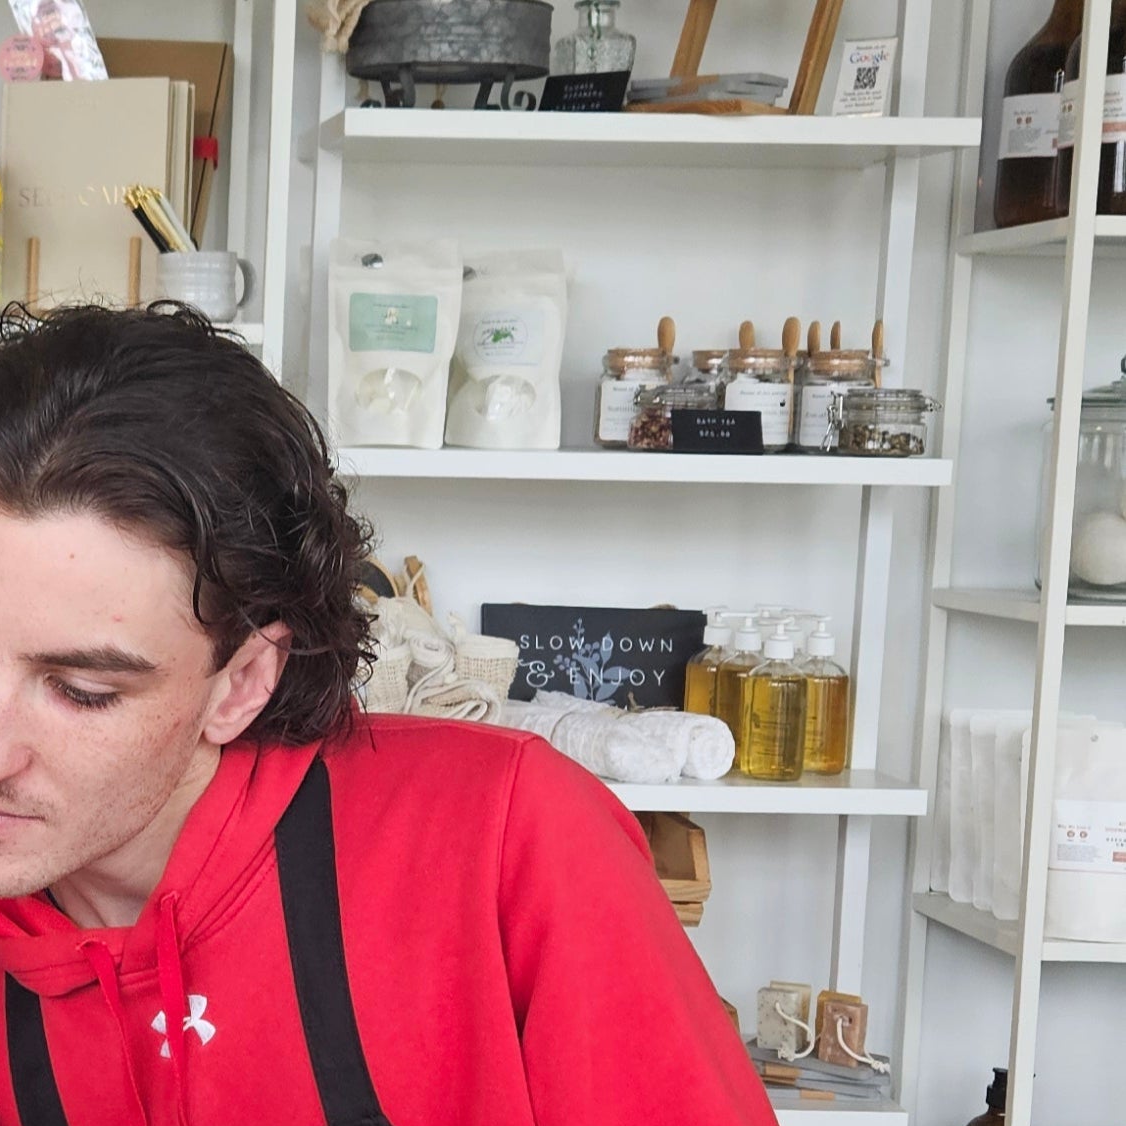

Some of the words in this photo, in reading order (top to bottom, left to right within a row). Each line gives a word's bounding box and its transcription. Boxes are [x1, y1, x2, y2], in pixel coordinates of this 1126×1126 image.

[850, 49, 890, 66] Google
[520, 634, 585, 651] SLOW
[601, 636, 673, 653] DOWN
[517, 659, 555, 688] &
[569, 667, 666, 687] ENJOY
